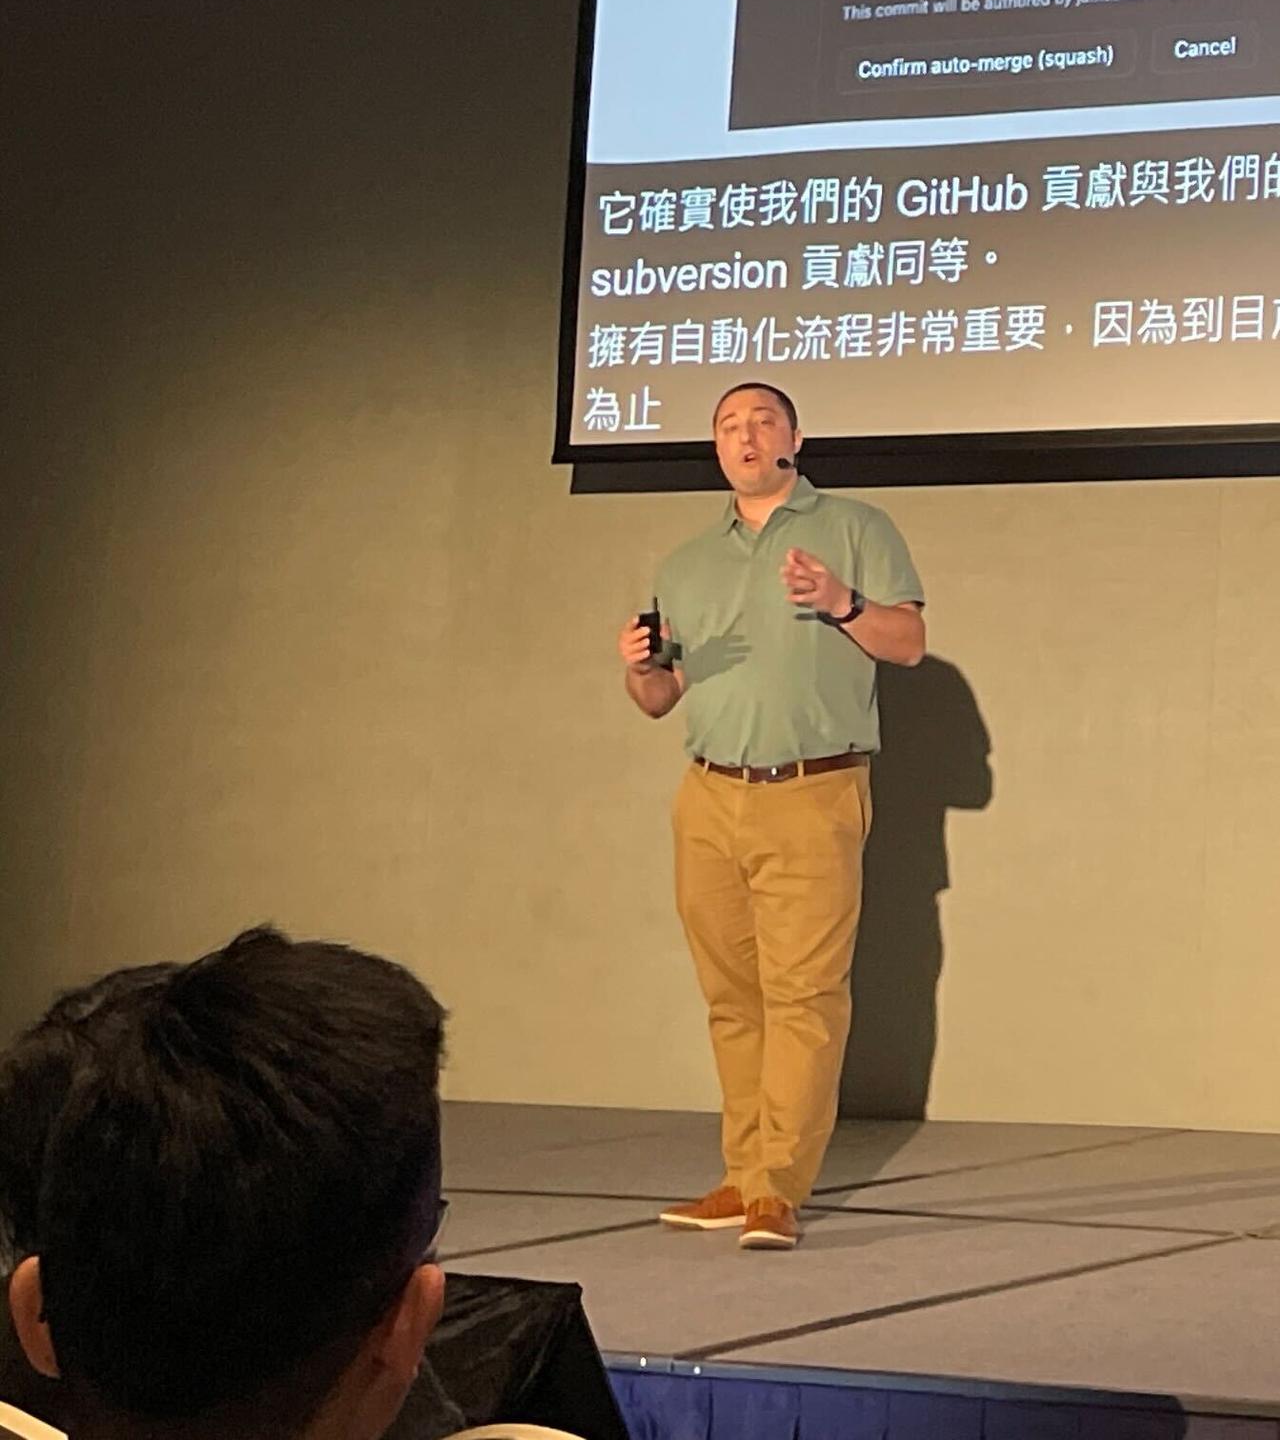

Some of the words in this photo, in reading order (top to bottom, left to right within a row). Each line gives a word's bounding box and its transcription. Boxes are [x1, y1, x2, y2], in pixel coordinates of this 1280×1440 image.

[842, 4, 872, 20] This
[875, 0, 929, 18] commit
[859, 58, 927, 78] Confirm
[931, 55, 1033, 74] auto-merge
[1038, 45, 1113, 71] (squash)
[1175, 36, 1236, 58] Cancel
[599, 176, 883, 235] 它確實使我們的
[897, 173, 1028, 216] GitHub
[591, 251, 788, 297] subversion
[583, 385, 662, 432] 為止
